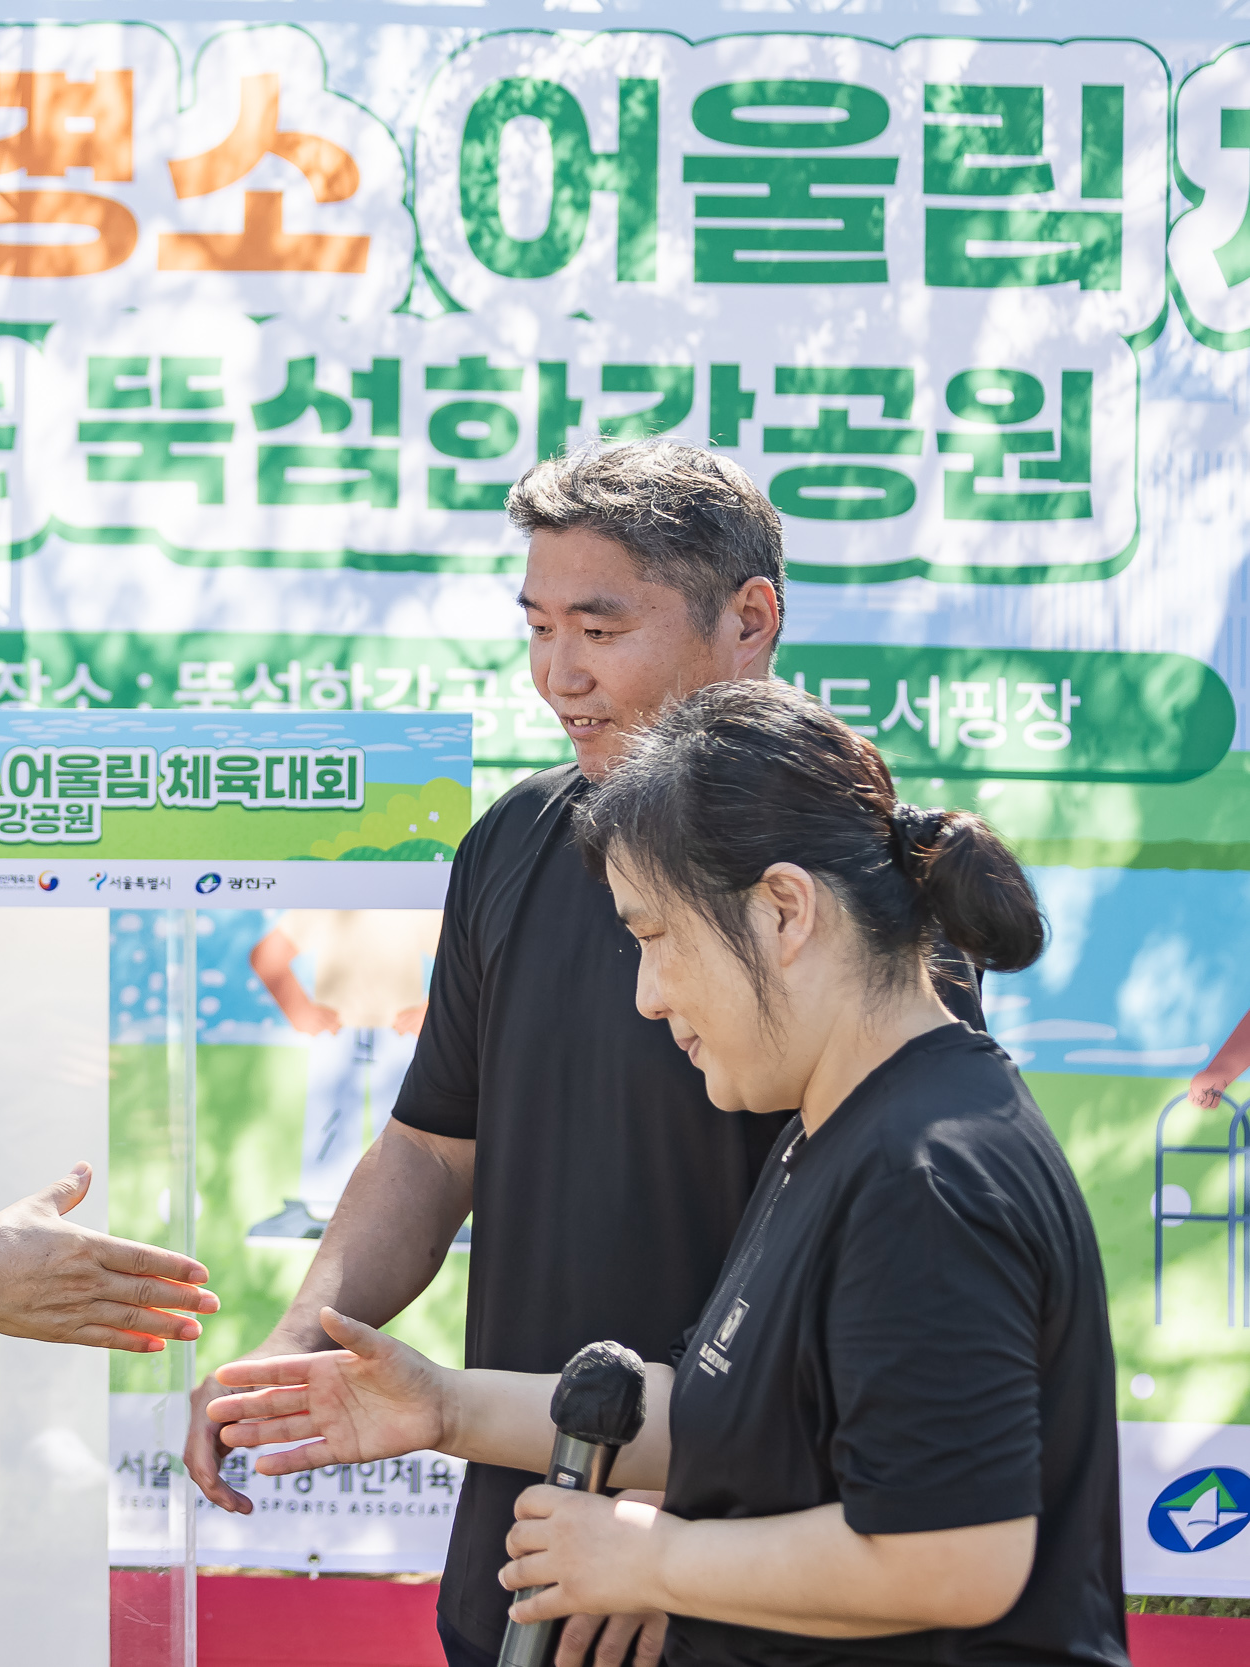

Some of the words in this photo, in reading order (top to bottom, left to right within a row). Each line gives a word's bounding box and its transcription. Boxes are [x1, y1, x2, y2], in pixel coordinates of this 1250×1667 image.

[459, 77, 1125, 290] 어울림
[794, 671, 1081, 750] 드서핑장
[8, 753, 150, 799] 어울림
[166, 754, 358, 801] 체육대회
[110, 876, 171, 890] 서울특별시
[228, 877, 276, 890] 광진구
[350, 1502, 451, 1515] ASSOCIAT
